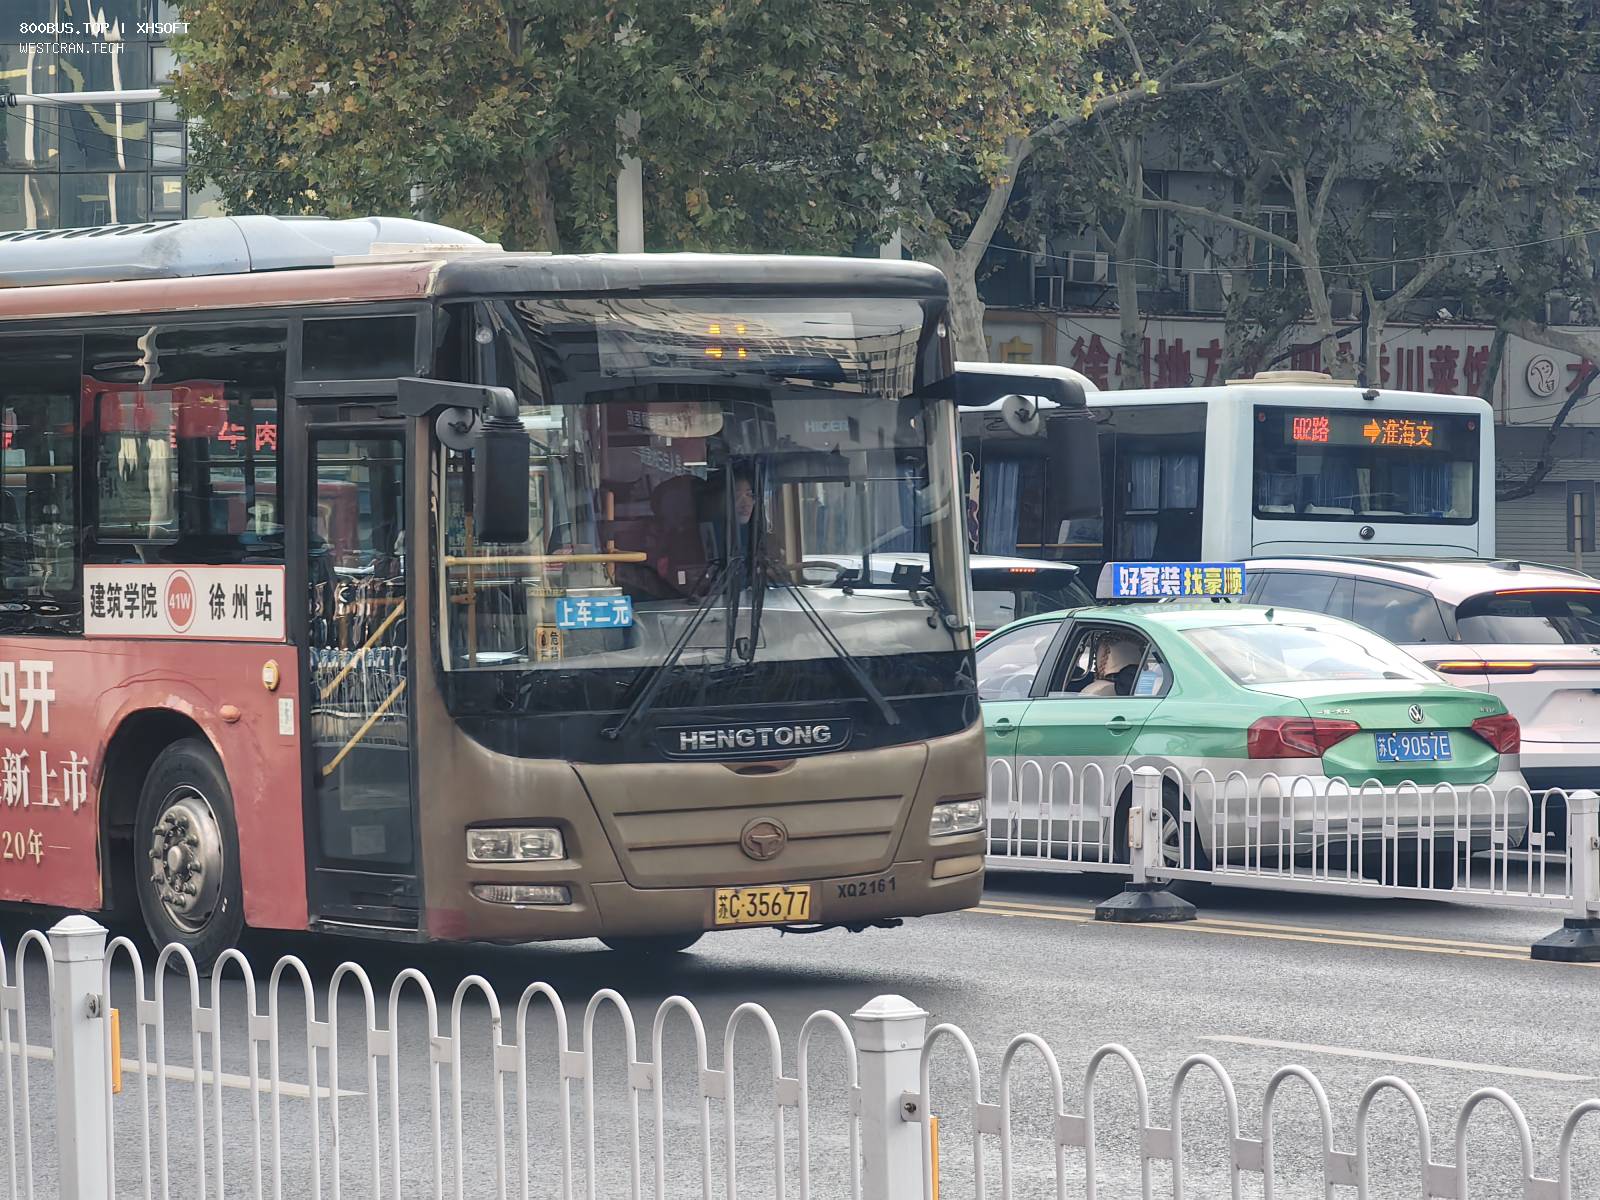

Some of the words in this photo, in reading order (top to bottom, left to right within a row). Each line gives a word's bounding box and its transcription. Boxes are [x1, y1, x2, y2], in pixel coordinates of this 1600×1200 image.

[1382, 418, 1433, 447] 淮海文
[90, 582, 158, 618] 建筑学院
[209, 583, 272, 622] 徐州站
[559, 599, 629, 627] 上车二元
[680, 725, 832, 751] HENGTONG
[0, 747, 89, 811] 新上市
[837, 877, 896, 898] XQ2161
